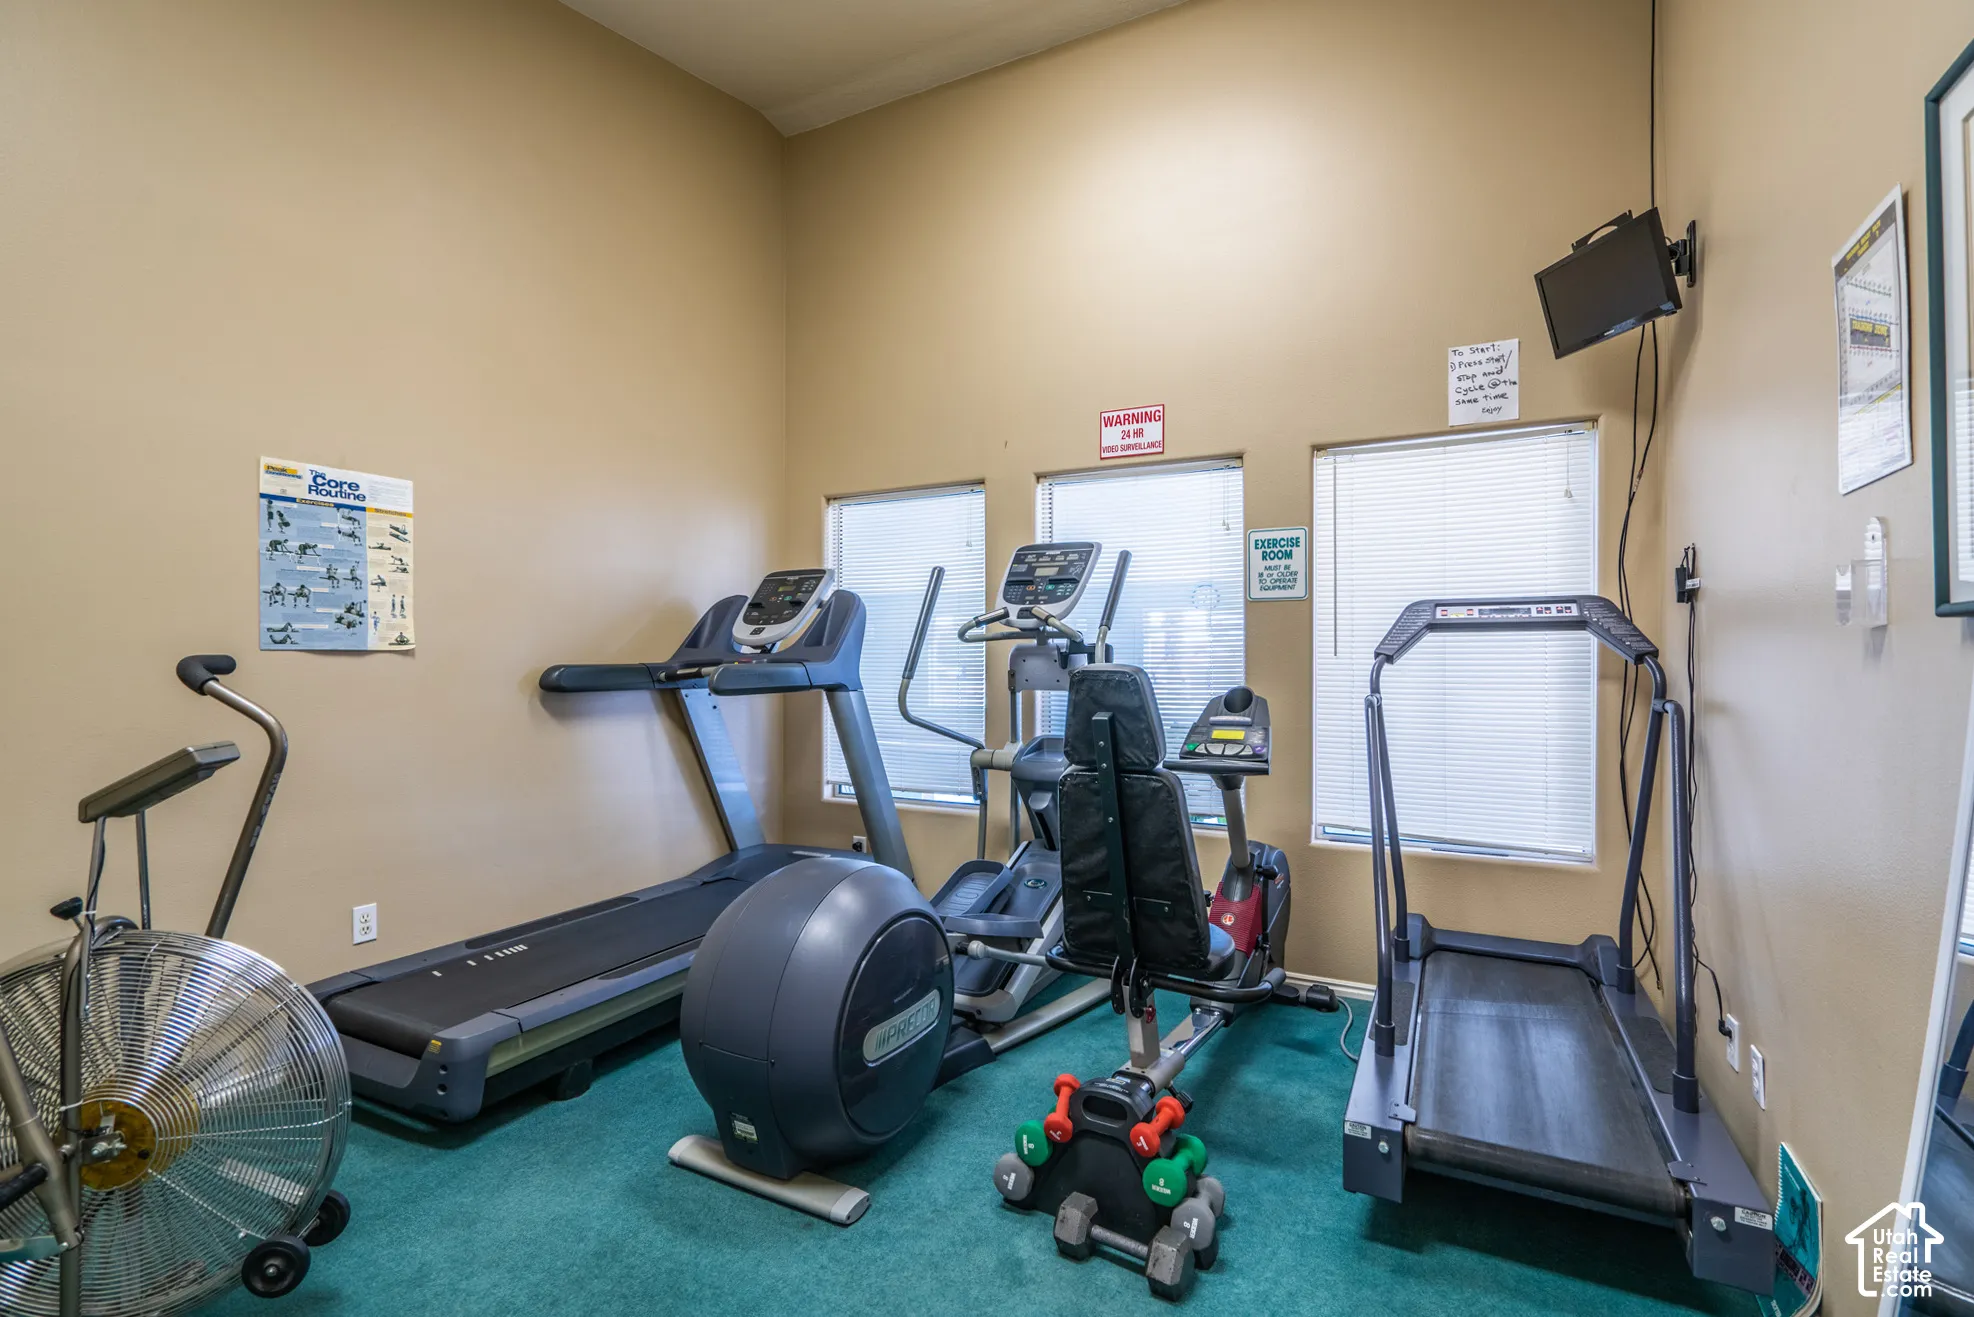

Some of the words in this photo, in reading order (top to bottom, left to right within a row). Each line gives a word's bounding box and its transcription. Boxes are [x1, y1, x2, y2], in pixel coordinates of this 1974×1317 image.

[1459, 360, 1482, 369] Press
[1103, 409, 1161, 428] WARNING
[1121, 429, 1131, 440] 24
[1133, 428, 1144, 439] HR
[1102, 445, 1118, 454] VIDEO
[1120, 440, 1162, 452] SURVEILLANCE
[309, 469, 326, 477] The
[312, 475, 360, 491] Core
[308, 484, 366, 502] Routine
[1254, 537, 1300, 550] EXERCISE
[1262, 549, 1293, 561] ROOM
[1159, 1178, 1164, 1186] 8
